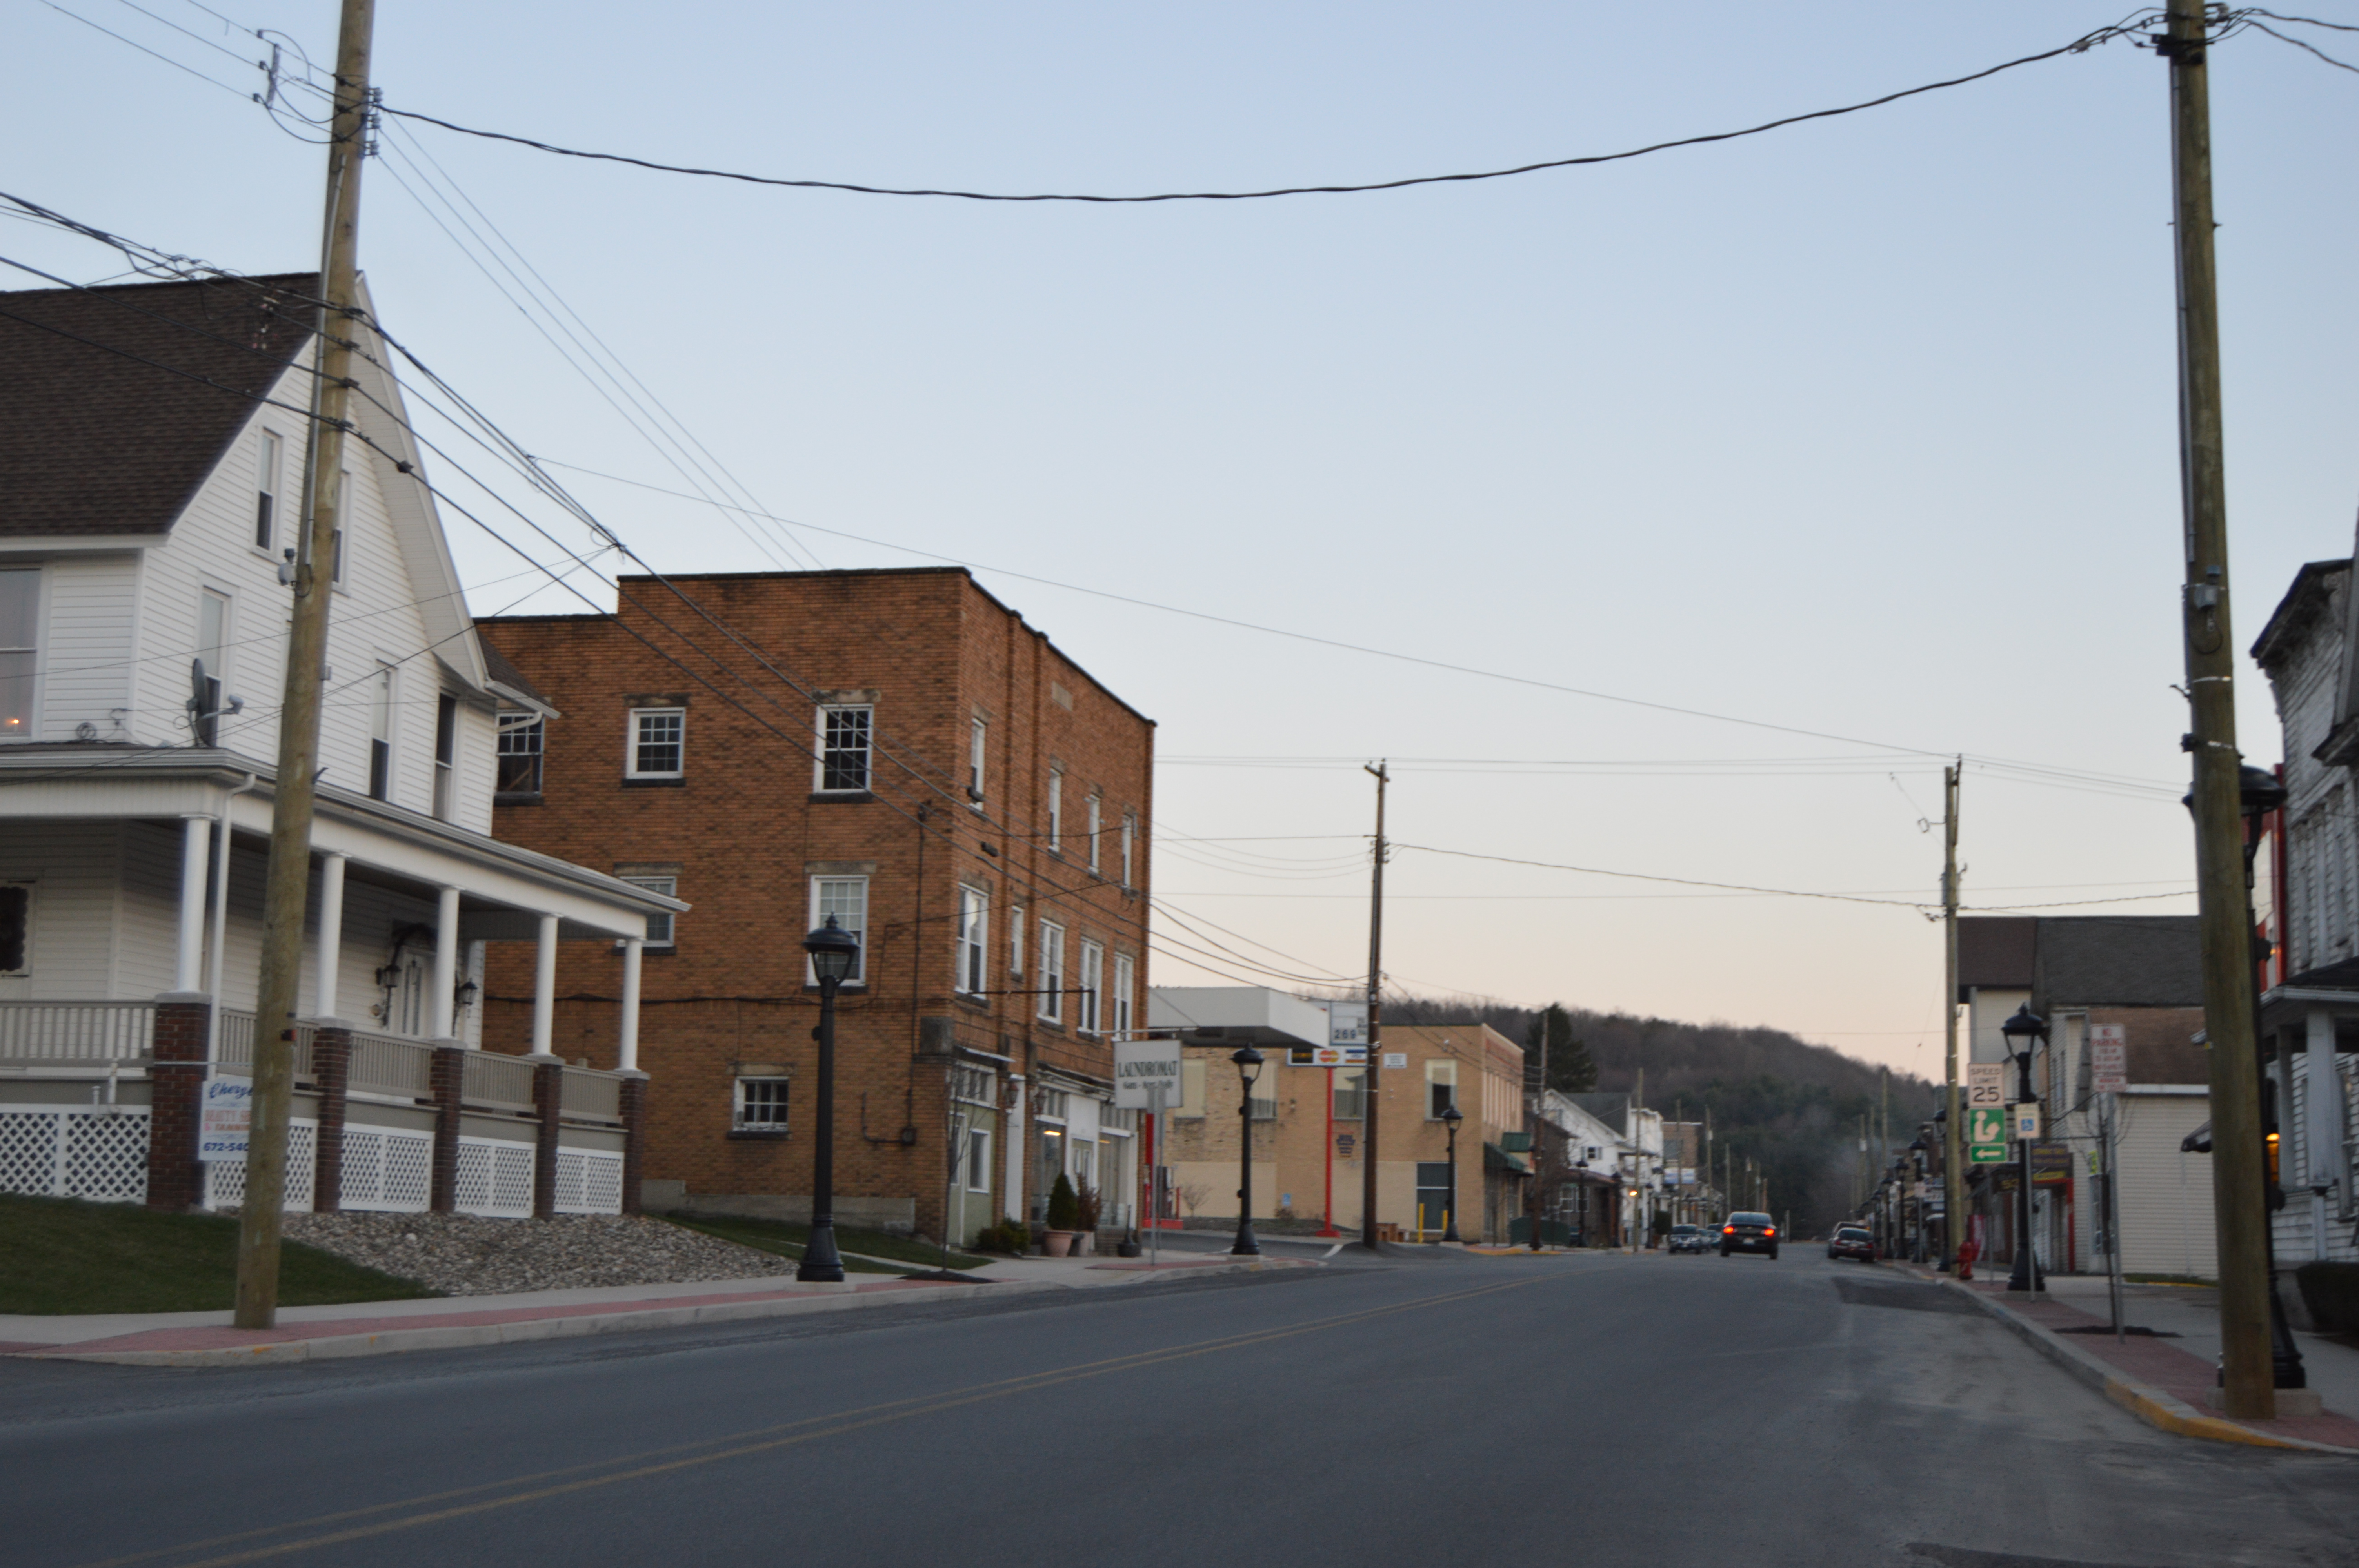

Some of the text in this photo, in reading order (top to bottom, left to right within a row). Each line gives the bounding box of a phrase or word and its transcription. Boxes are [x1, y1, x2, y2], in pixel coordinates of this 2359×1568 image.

[1335, 1029, 1357, 1039] 269
[1118, 1060, 1177, 1077] LAUNDROMAT
[1973, 1086, 1999, 1102] 25
[204, 1142, 249, 1151] 672-540
